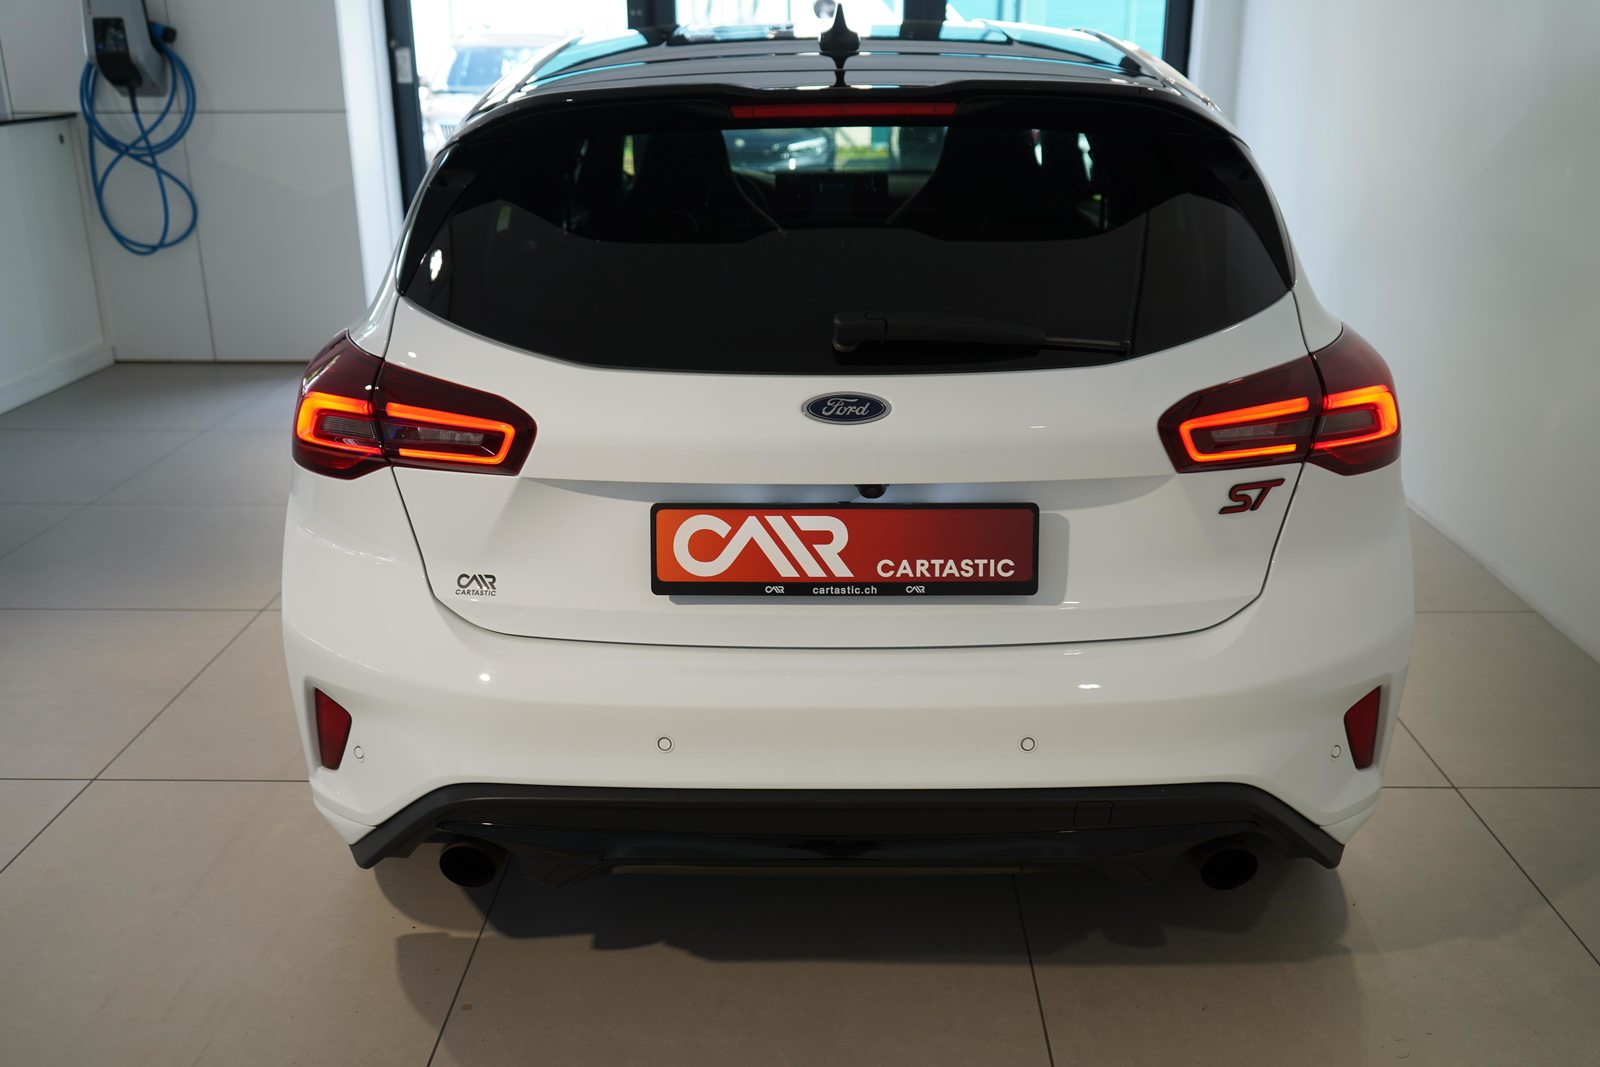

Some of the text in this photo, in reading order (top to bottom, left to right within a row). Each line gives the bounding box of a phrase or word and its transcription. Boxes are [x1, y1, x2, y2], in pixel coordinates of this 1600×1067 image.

[822, 398, 870, 416] Ford
[1218, 478, 1286, 514] ST
[876, 558, 1015, 578] CARTASTIC
[812, 585, 877, 595] cartastic.ch
